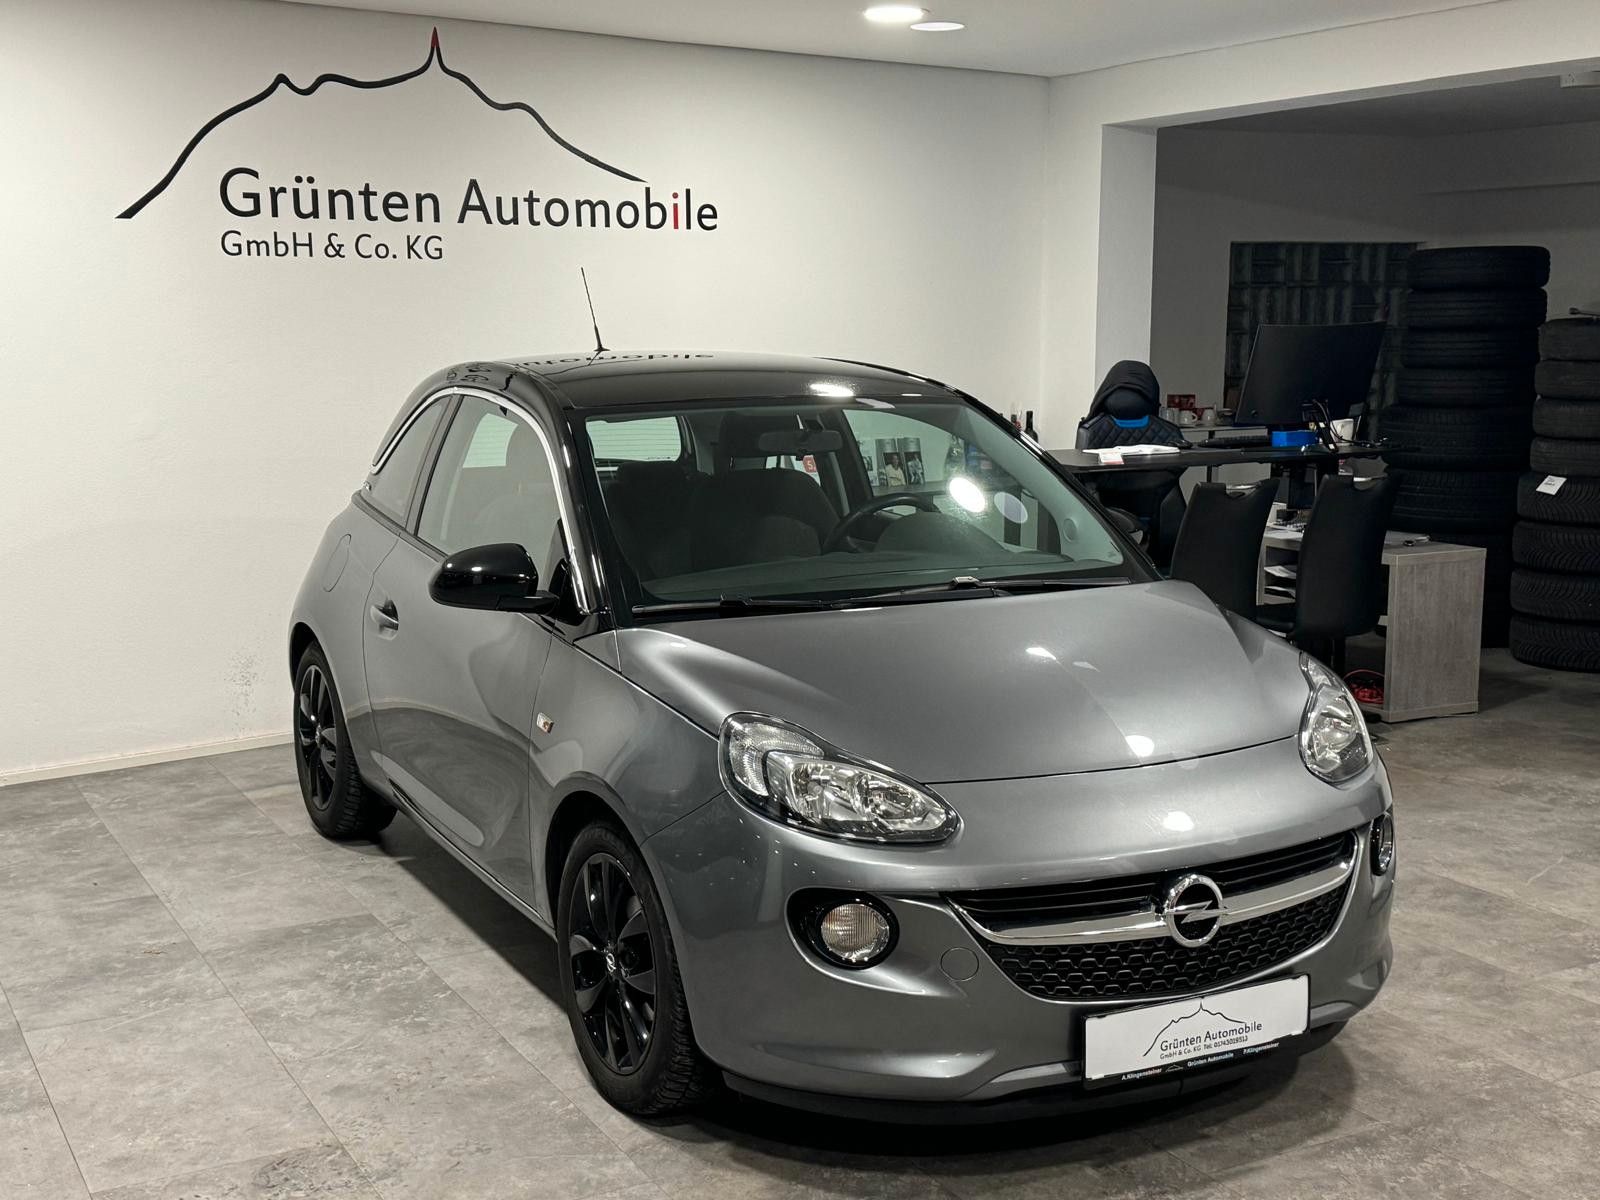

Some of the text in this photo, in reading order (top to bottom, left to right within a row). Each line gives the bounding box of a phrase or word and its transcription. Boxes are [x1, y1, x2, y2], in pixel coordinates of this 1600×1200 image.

[220, 167, 719, 231] Grünten Automobile
[221, 229, 443, 260] GmbH & Co. KG
[1160, 1021, 1263, 1052] Grünten Automobile
[1160, 1048, 1178, 1060] GmbH
[1184, 1046, 1193, 1055] Co.
[1194, 1044, 1202, 1052] KG
[1207, 1053, 1235, 1064] Automobile
